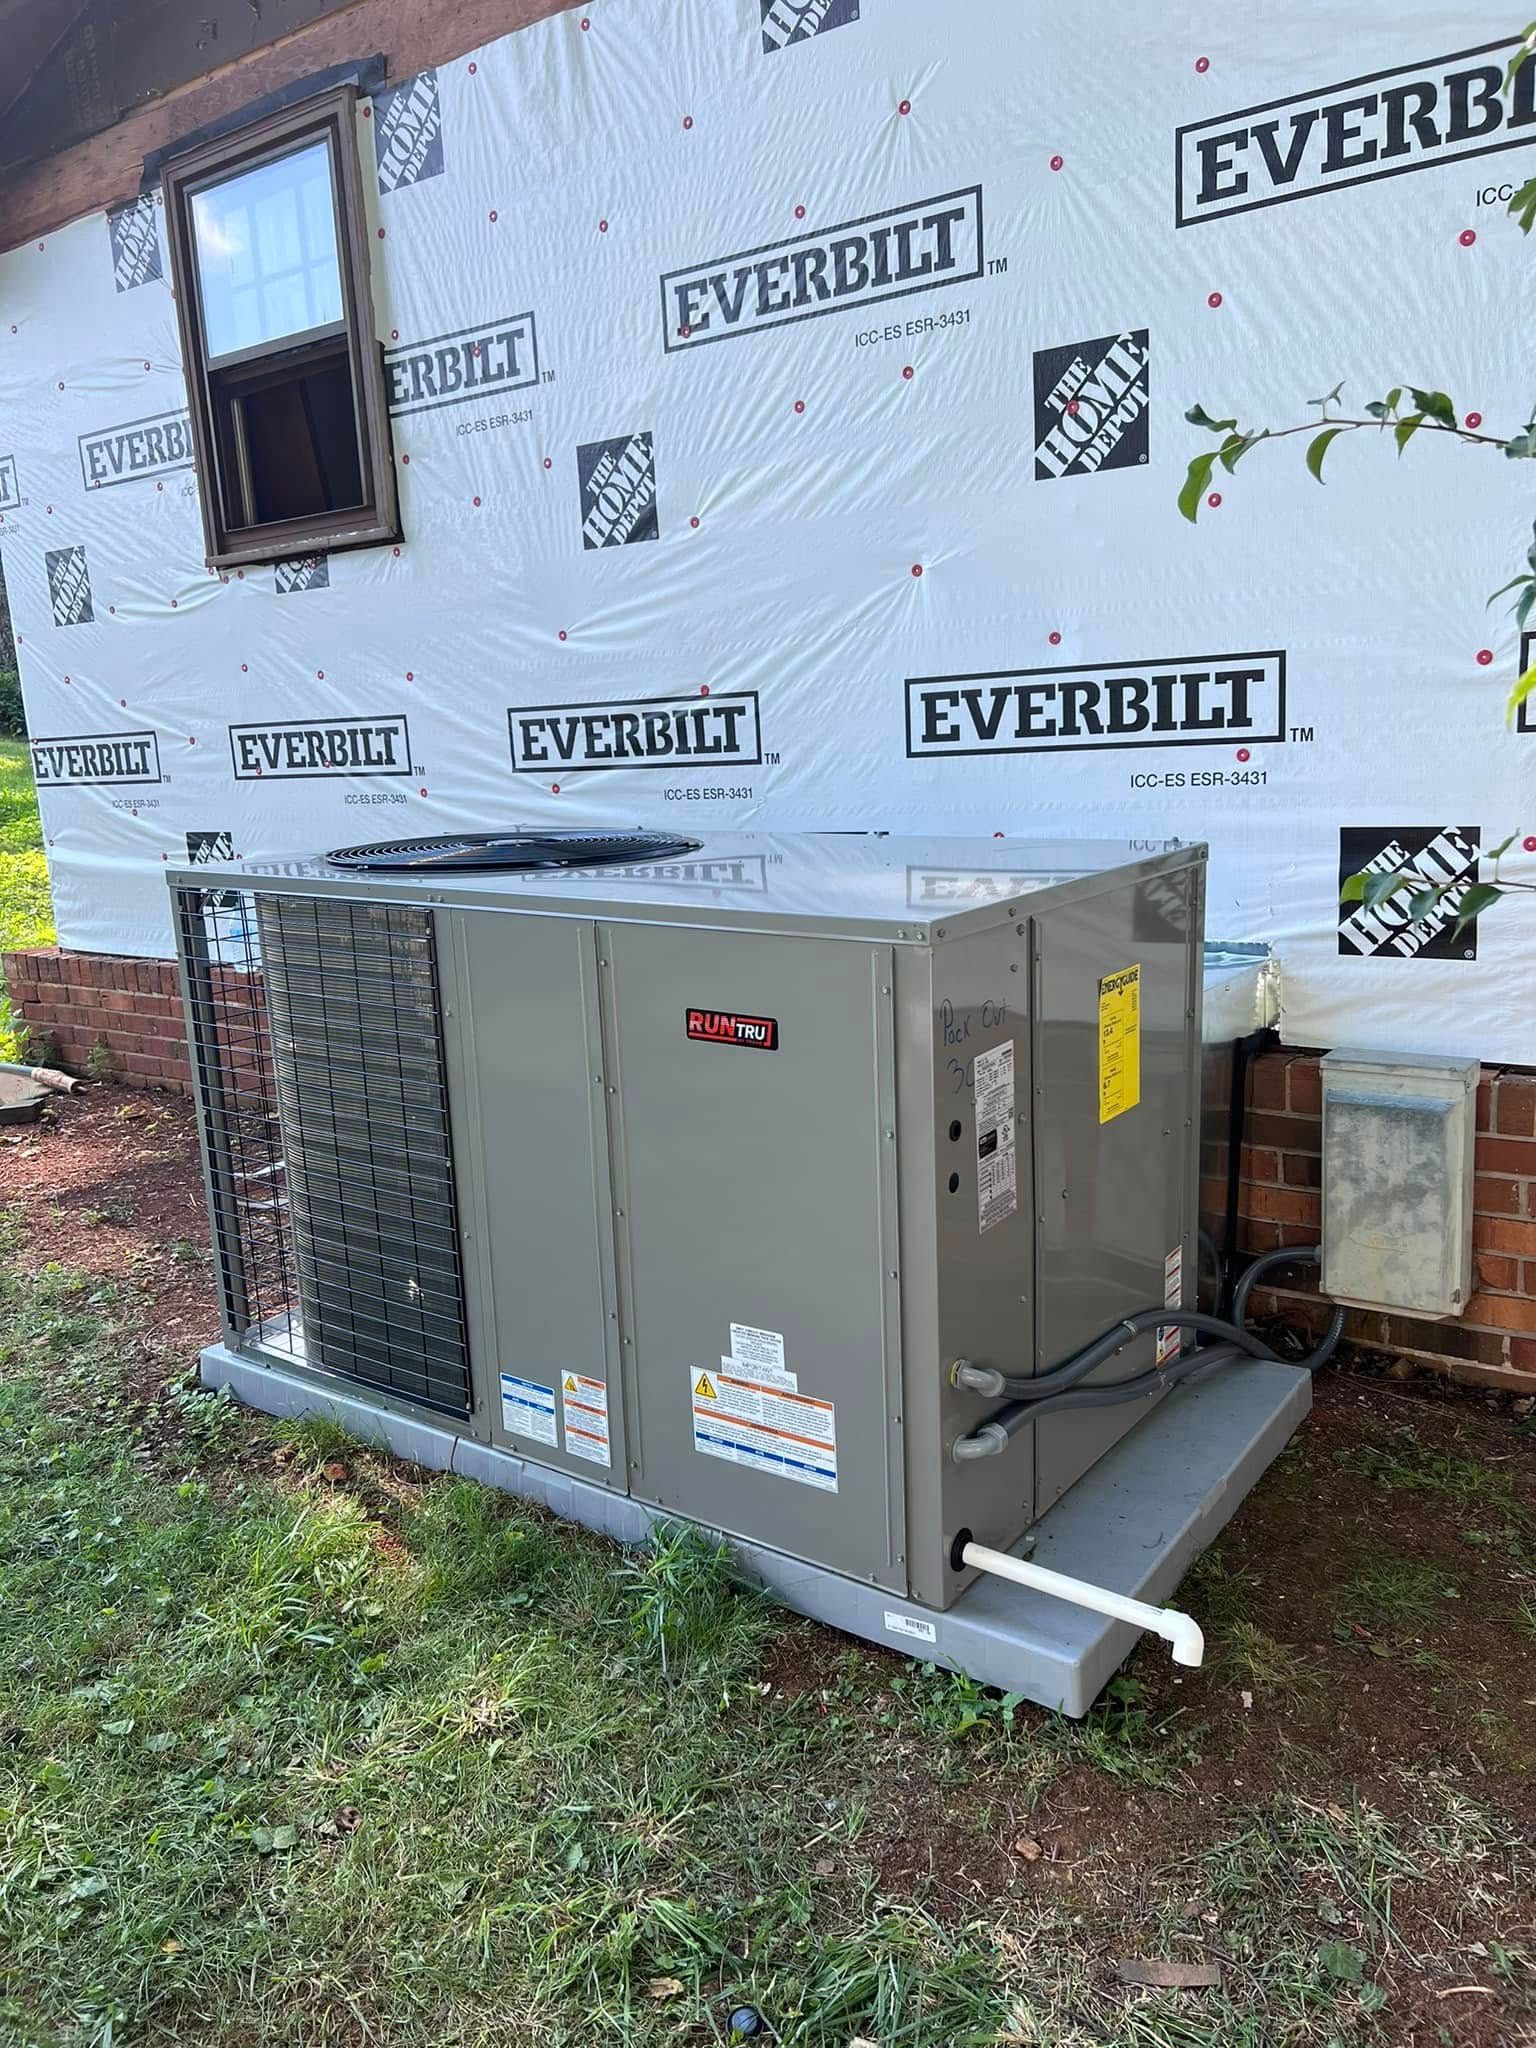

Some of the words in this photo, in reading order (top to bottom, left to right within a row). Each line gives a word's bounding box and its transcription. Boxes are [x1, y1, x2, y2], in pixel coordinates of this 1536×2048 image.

[378, 71, 438, 191] HOME
[380, 91, 407, 138] THE
[1196, 53, 1536, 204] EVERBI
[403, 105, 440, 184] DEPOT
[674, 206, 965, 337] EVERBILT
[855, 325, 902, 348] ICC-ES
[906, 308, 972, 337] ESR-3431
[384, 327, 525, 407] ERBILT
[1043, 356, 1092, 413] THE
[456, 419, 488, 437] ICC-ES
[489, 409, 534, 430] ESR-3431
[1035, 332, 1150, 478] HOME
[1078, 380, 1150, 472] DEPOT
[86, 418, 194, 480] EVERBI
[586, 450, 617, 496] THE
[583, 433, 654, 548] HOME
[612, 472, 656, 544] DEPOT
[518, 706, 746, 761] EVERBILT
[921, 669, 1265, 744] EVERBILT
[32, 741, 151, 779] EVERBILT
[237, 726, 399, 771] EVERBILT
[344, 794, 370, 805] ICC-ES
[371, 794, 408, 805] ESR-3431
[664, 788, 701, 801] ICC-ES
[703, 787, 753, 800] ESR-3431
[1130, 773, 1186, 789] ICC-ES
[1190, 771, 1268, 787] ESR-3431
[1360, 840, 1411, 876] HE
[1391, 876, 1472, 957] DEPO
